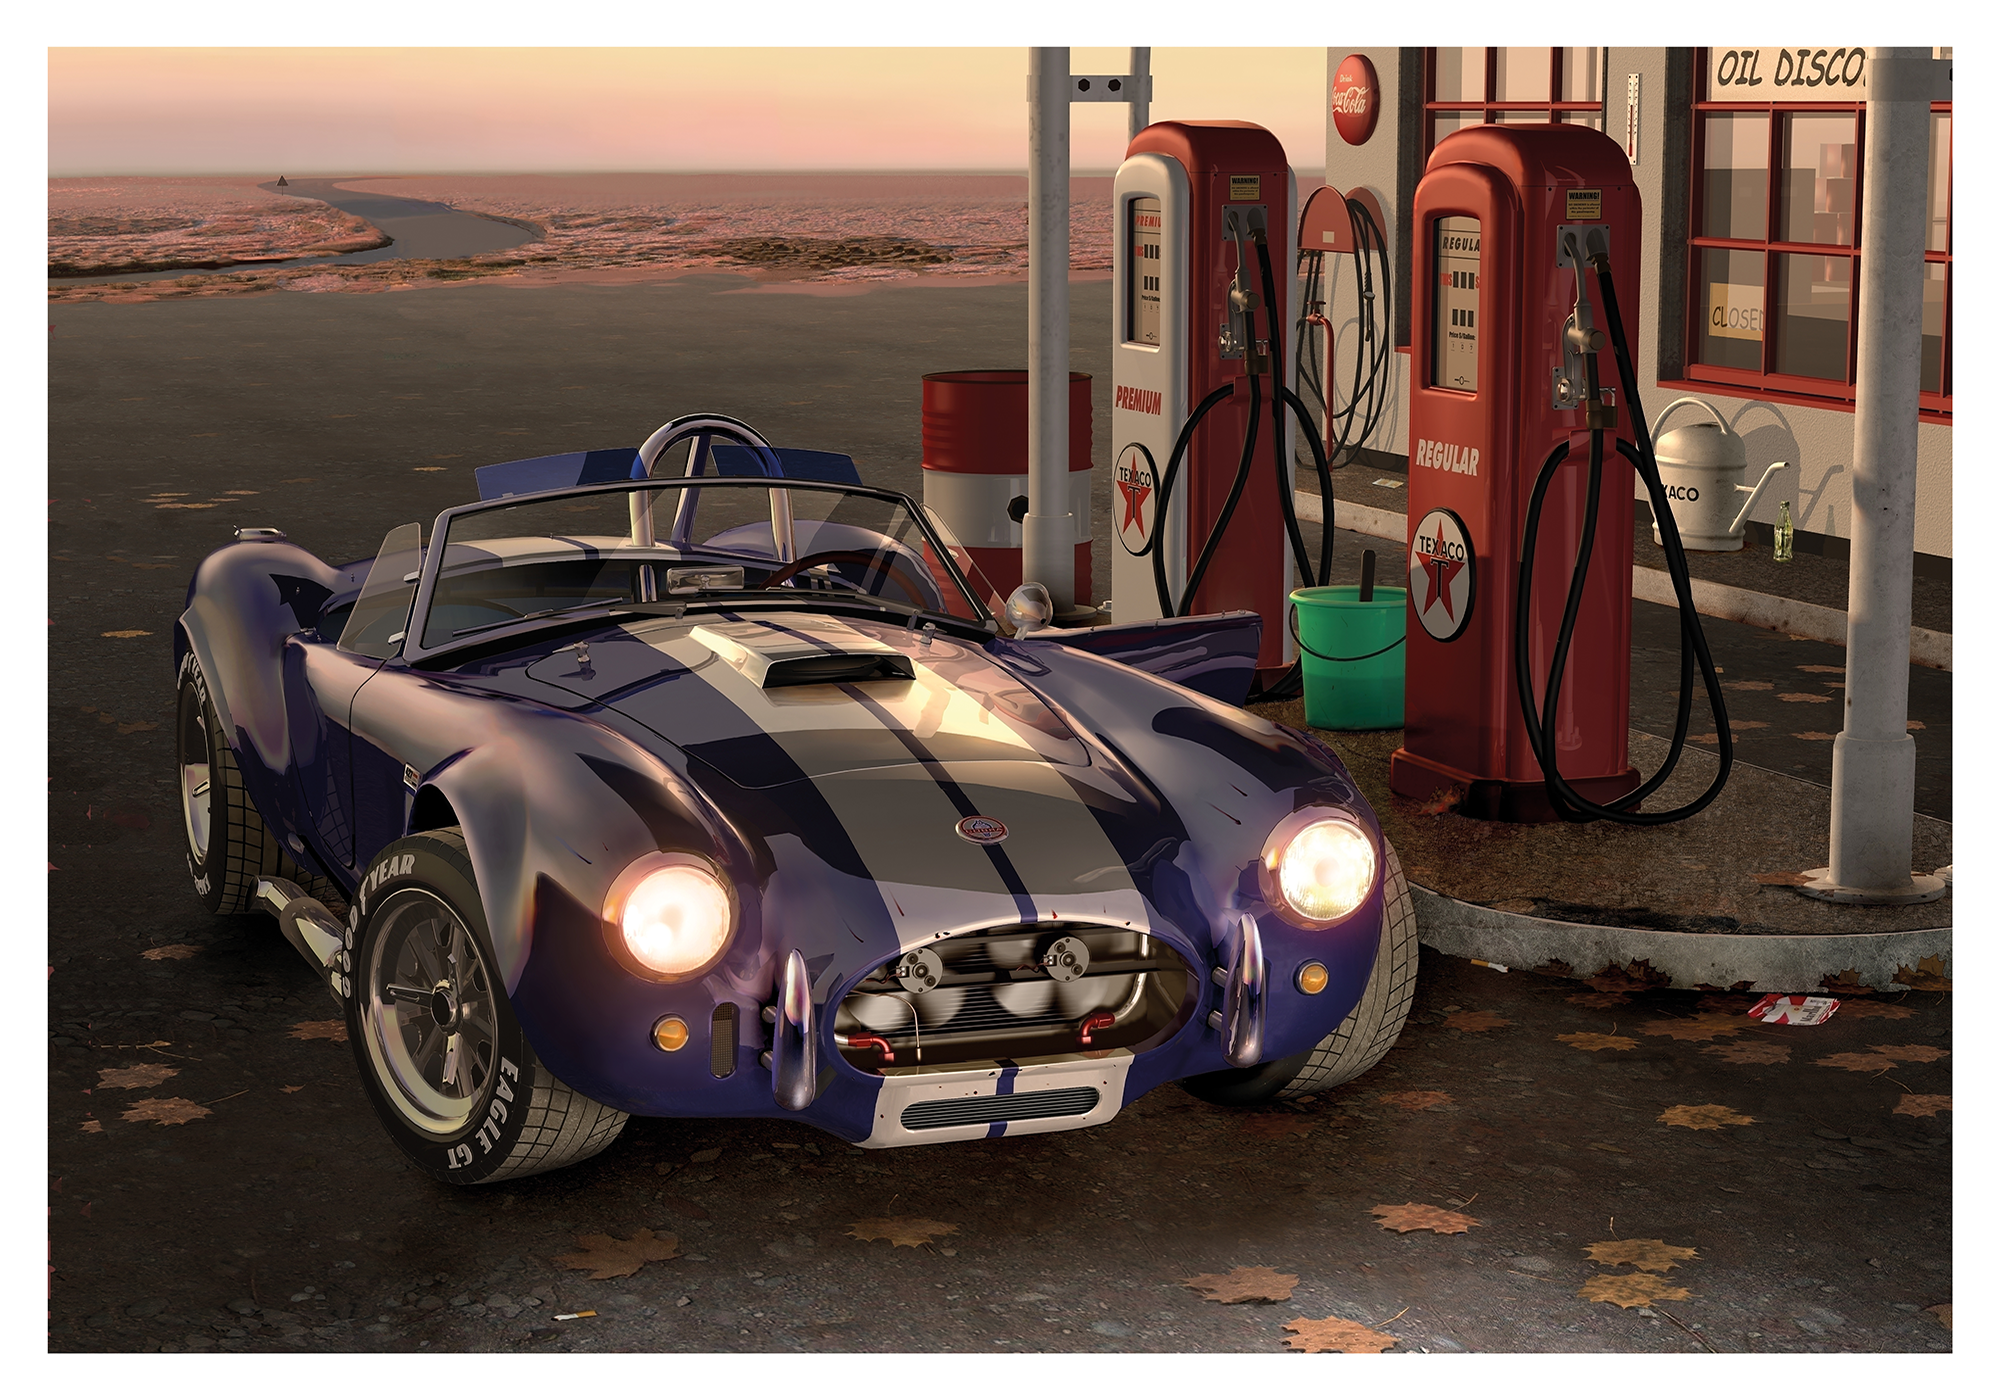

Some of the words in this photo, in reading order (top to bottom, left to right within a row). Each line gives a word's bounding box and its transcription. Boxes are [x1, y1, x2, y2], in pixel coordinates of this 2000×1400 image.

[1340, 74, 1353, 83] Drink
[1717, 49, 1762, 86] OIL
[1774, 47, 1865, 87] DISCO
[1568, 192, 1600, 200] WARNING!
[1115, 385, 1162, 416] PREMIUM
[1415, 438, 1480, 477] REGULAR
[1119, 466, 1152, 488] TEXACO
[1419, 535, 1465, 561] TEXACO
[475, 1056, 519, 1155] EAGLE
[447, 1143, 473, 1170] GT
